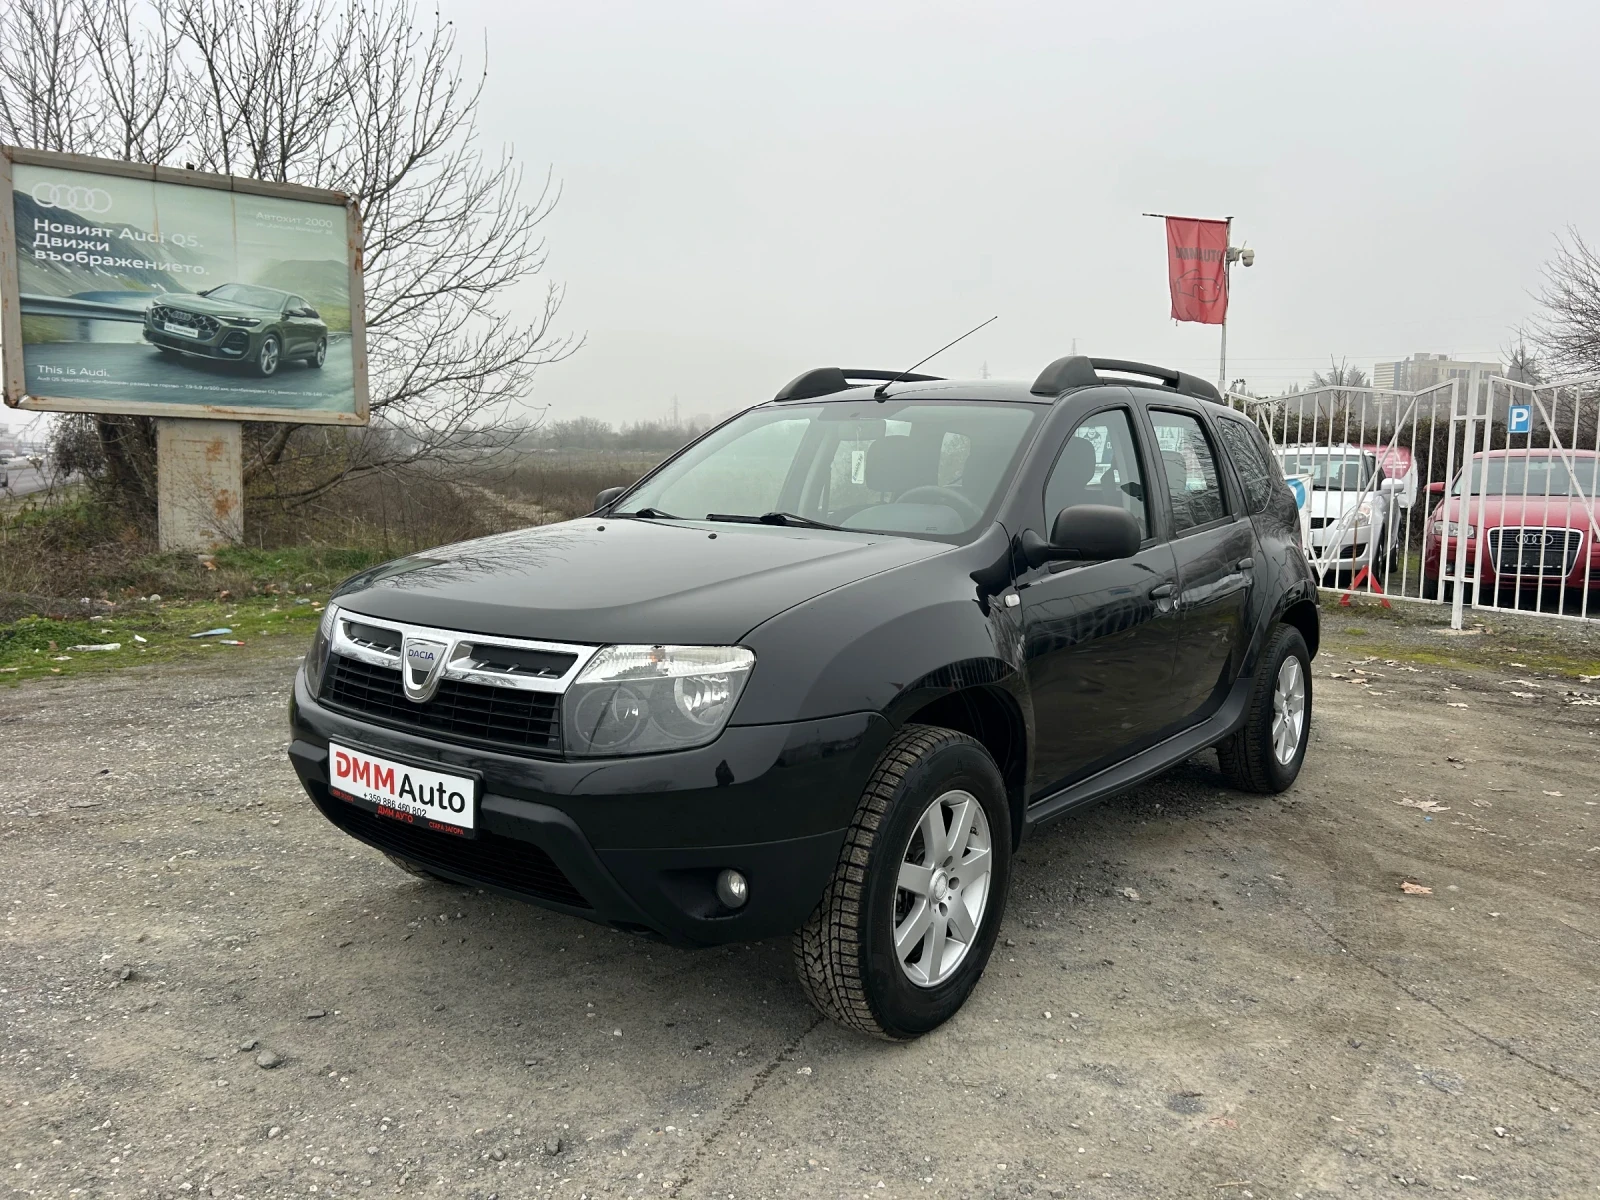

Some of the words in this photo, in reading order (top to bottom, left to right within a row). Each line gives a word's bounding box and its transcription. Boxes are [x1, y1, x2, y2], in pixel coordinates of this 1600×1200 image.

[256, 211, 301, 224] Автохит
[305, 217, 333, 228] 2000
[33, 218, 113, 239] Новият
[118, 227, 165, 244] Audi
[32, 232, 110, 252] Движи
[35, 250, 210, 276] въображението.
[36, 364, 63, 375] This
[66, 366, 76, 375] is
[79, 367, 110, 377] Audi.
[1511, 407, 1529, 430] P
[408, 649, 434, 660] DACIA
[412, 806, 427, 818] 802
